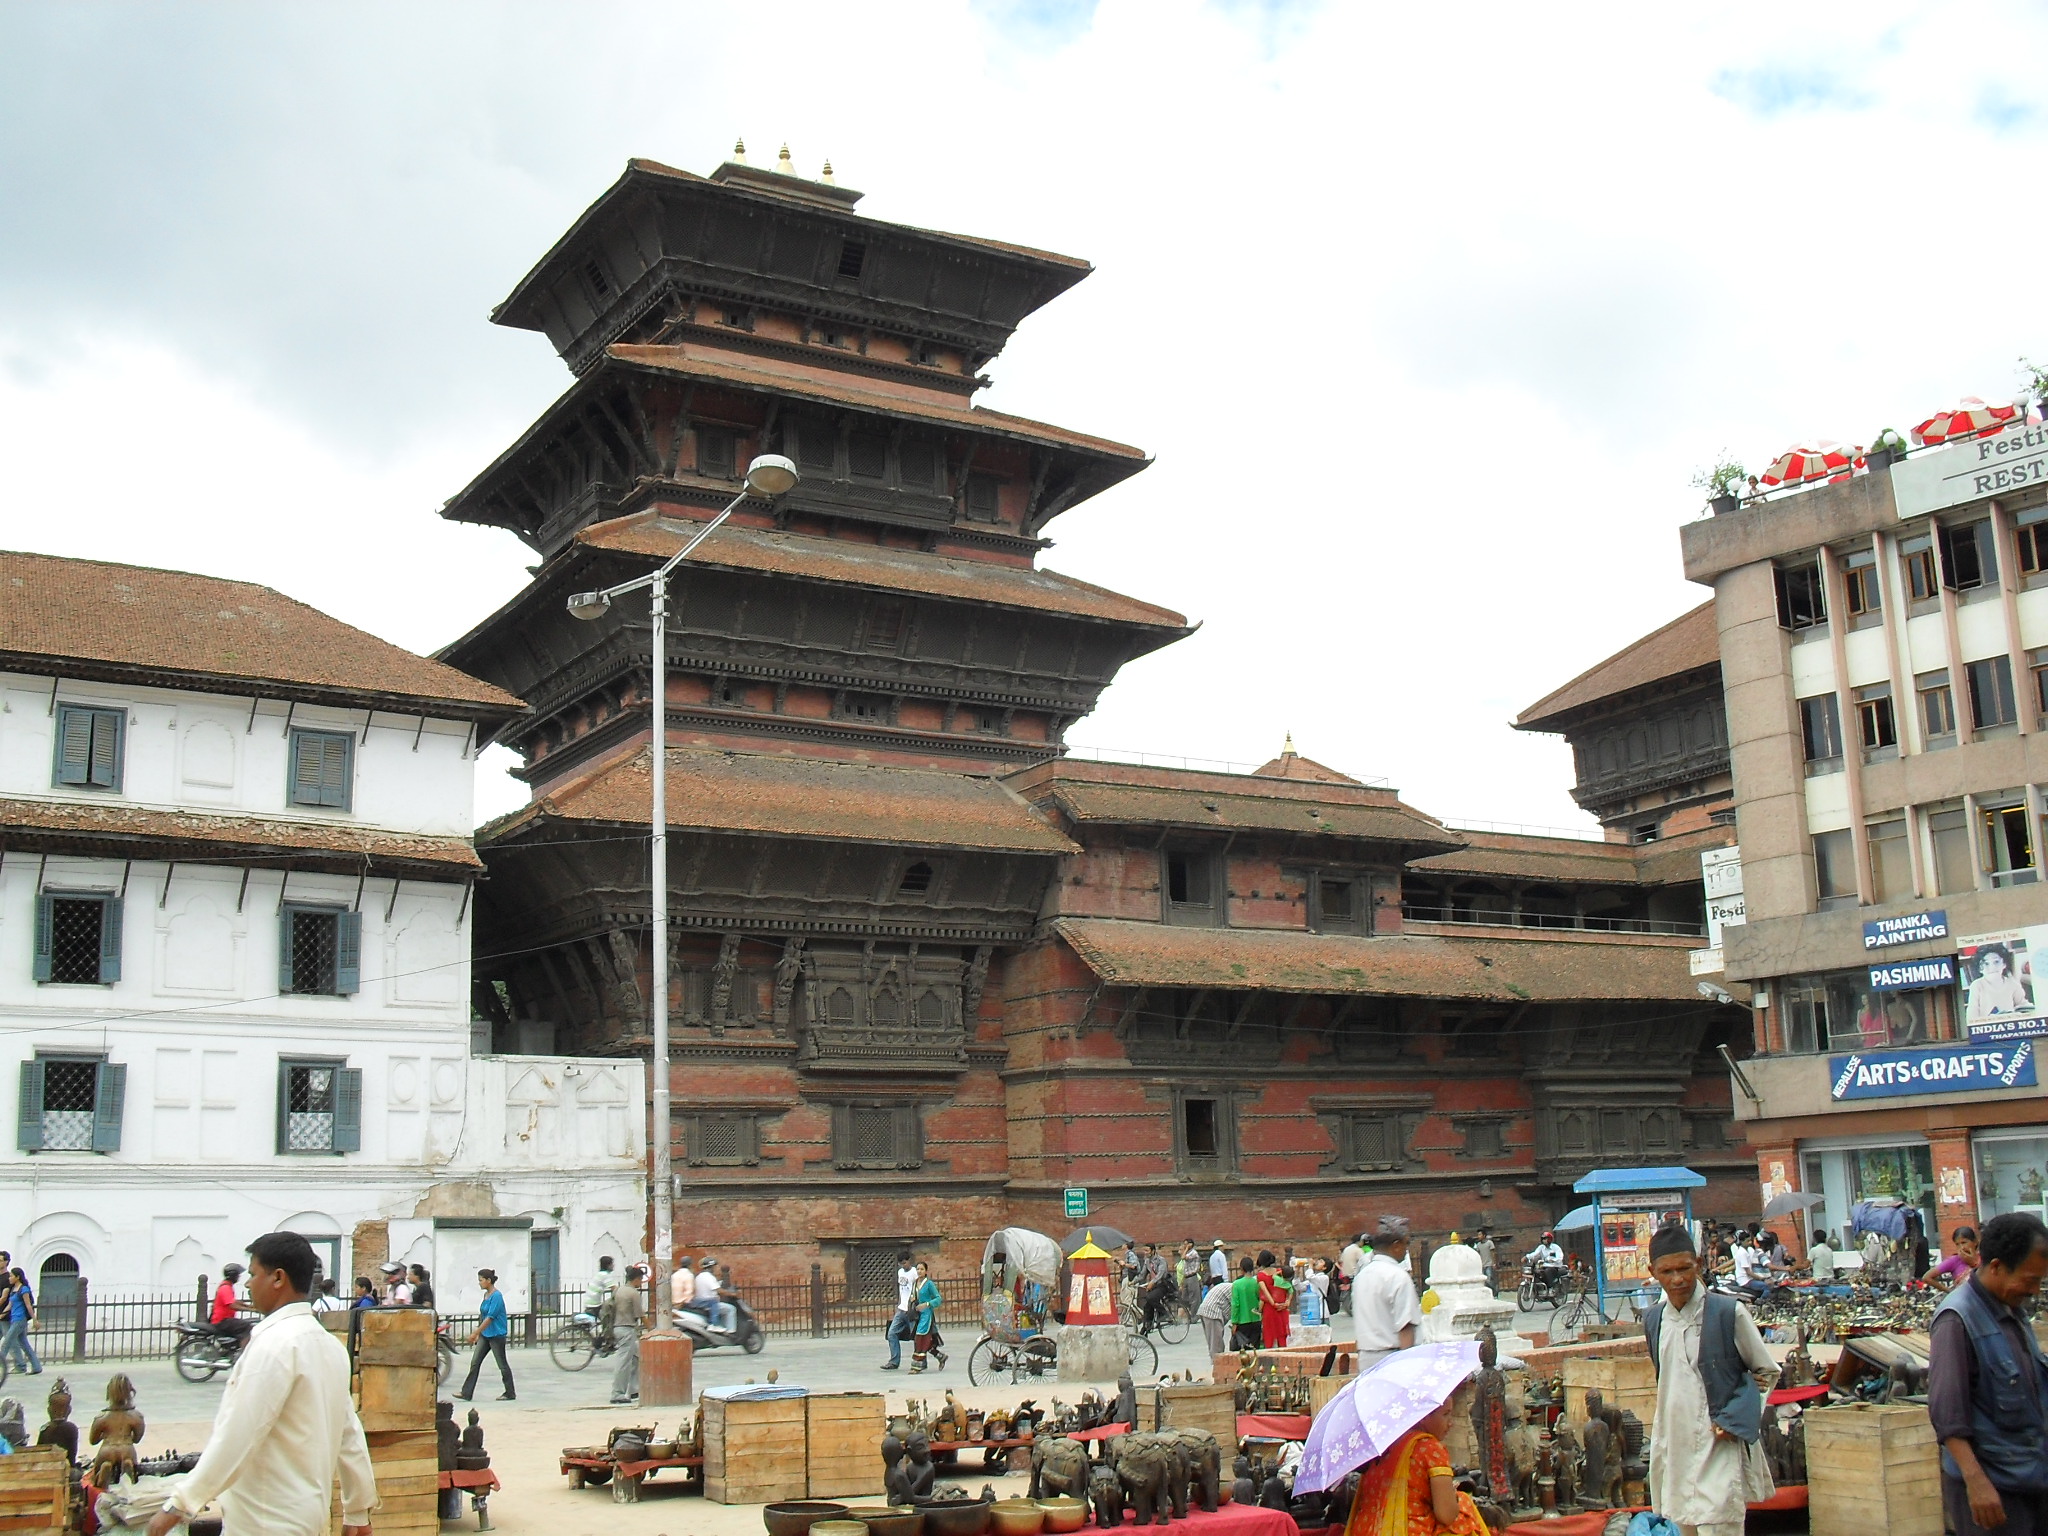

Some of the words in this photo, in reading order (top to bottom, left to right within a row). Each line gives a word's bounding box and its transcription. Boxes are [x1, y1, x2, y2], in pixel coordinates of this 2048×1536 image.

[1974, 459, 2048, 494] REST
[1865, 925, 1946, 947] PAINTING
[1877, 914, 1930, 932] THANKA
[1870, 963, 1952, 987] PASHMINA
[1971, 1022, 2016, 1035] INDIA'S
[2018, 1019, 2047, 1030] NO.1
[1832, 1054, 1862, 1098] NEPALESE
[1856, 1060, 1911, 1086] ARTS
[1911, 1066, 1919, 1077] &
[1920, 1053, 2003, 1081] CRAFTS
[2001, 1041, 2031, 1086] EXPORTS
